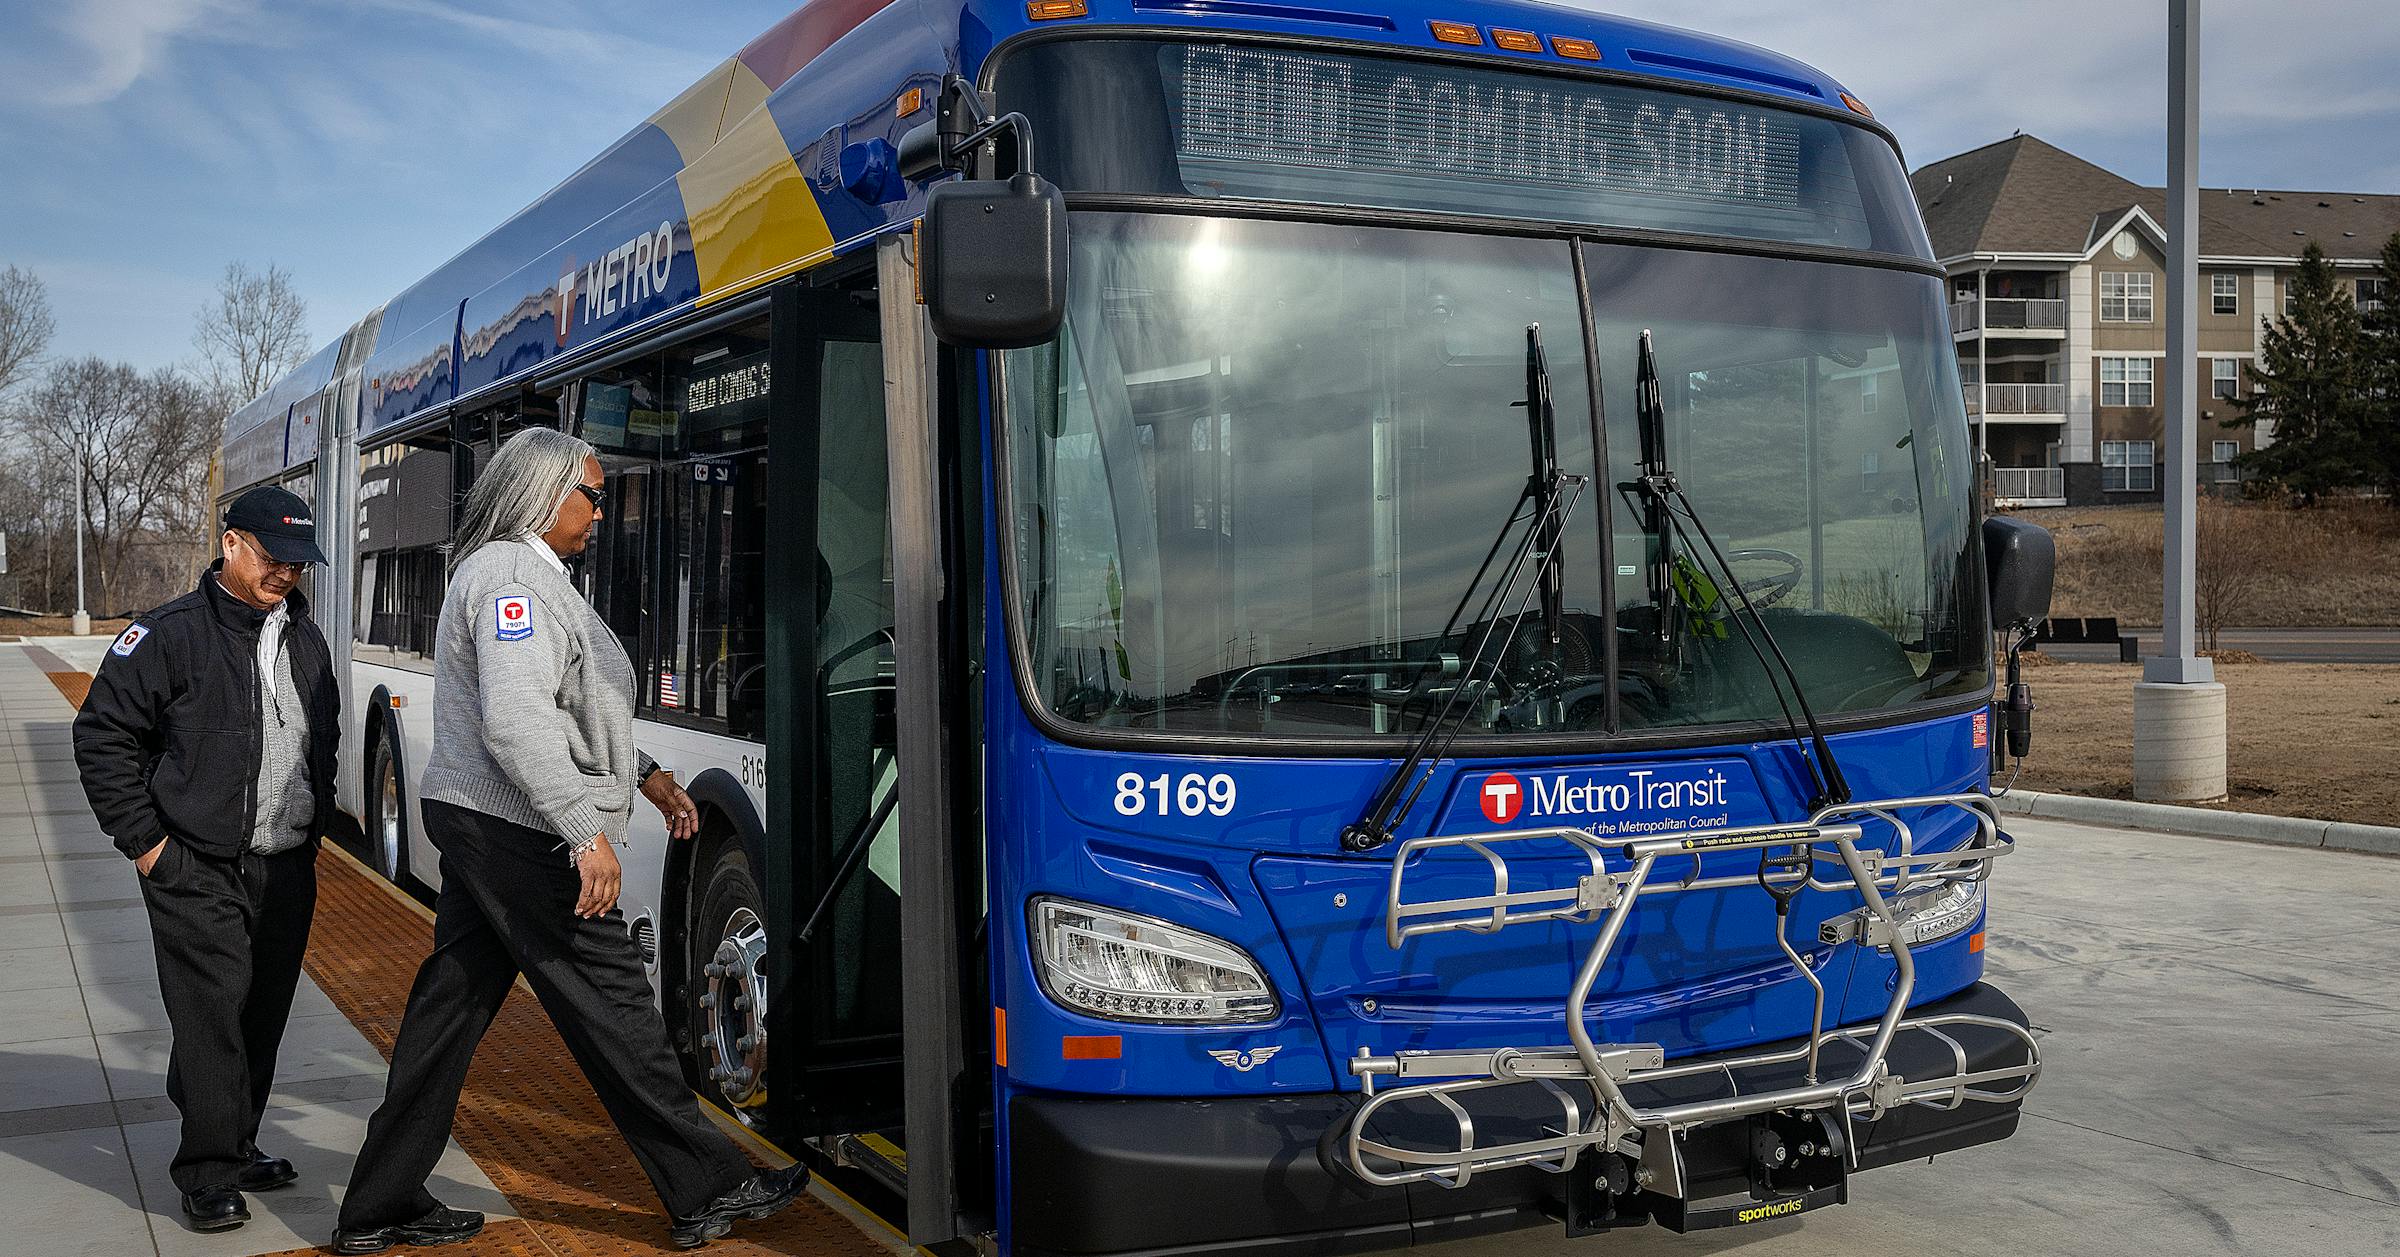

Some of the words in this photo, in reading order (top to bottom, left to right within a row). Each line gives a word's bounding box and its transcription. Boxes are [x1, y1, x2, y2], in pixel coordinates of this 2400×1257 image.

[1387, 74, 1608, 182] COMING
[1633, 103, 1767, 197] SOON
[584, 220, 673, 325] METRO
[688, 377, 716, 412] GOLD
[719, 365, 757, 405] COMING
[505, 621, 526, 629] 79071
[741, 754, 767, 790] 816
[1113, 772, 1237, 817] 8169
[1585, 822, 1598, 835] of
[1598, 821, 1617, 835] the
[1618, 816, 1686, 834] Metropolitan
[1689, 812, 1728, 829] Council
[1703, 838, 1718, 846] Push
[1719, 837, 1732, 845] rack
[1732, 836, 1743, 844] and
[1744, 834, 1767, 844] squeeze
[1767, 832, 1786, 841] handle
[1786, 831, 1793, 839] to
[1793, 830, 1809, 839] lower
[1738, 1199, 1802, 1223] sportworks
